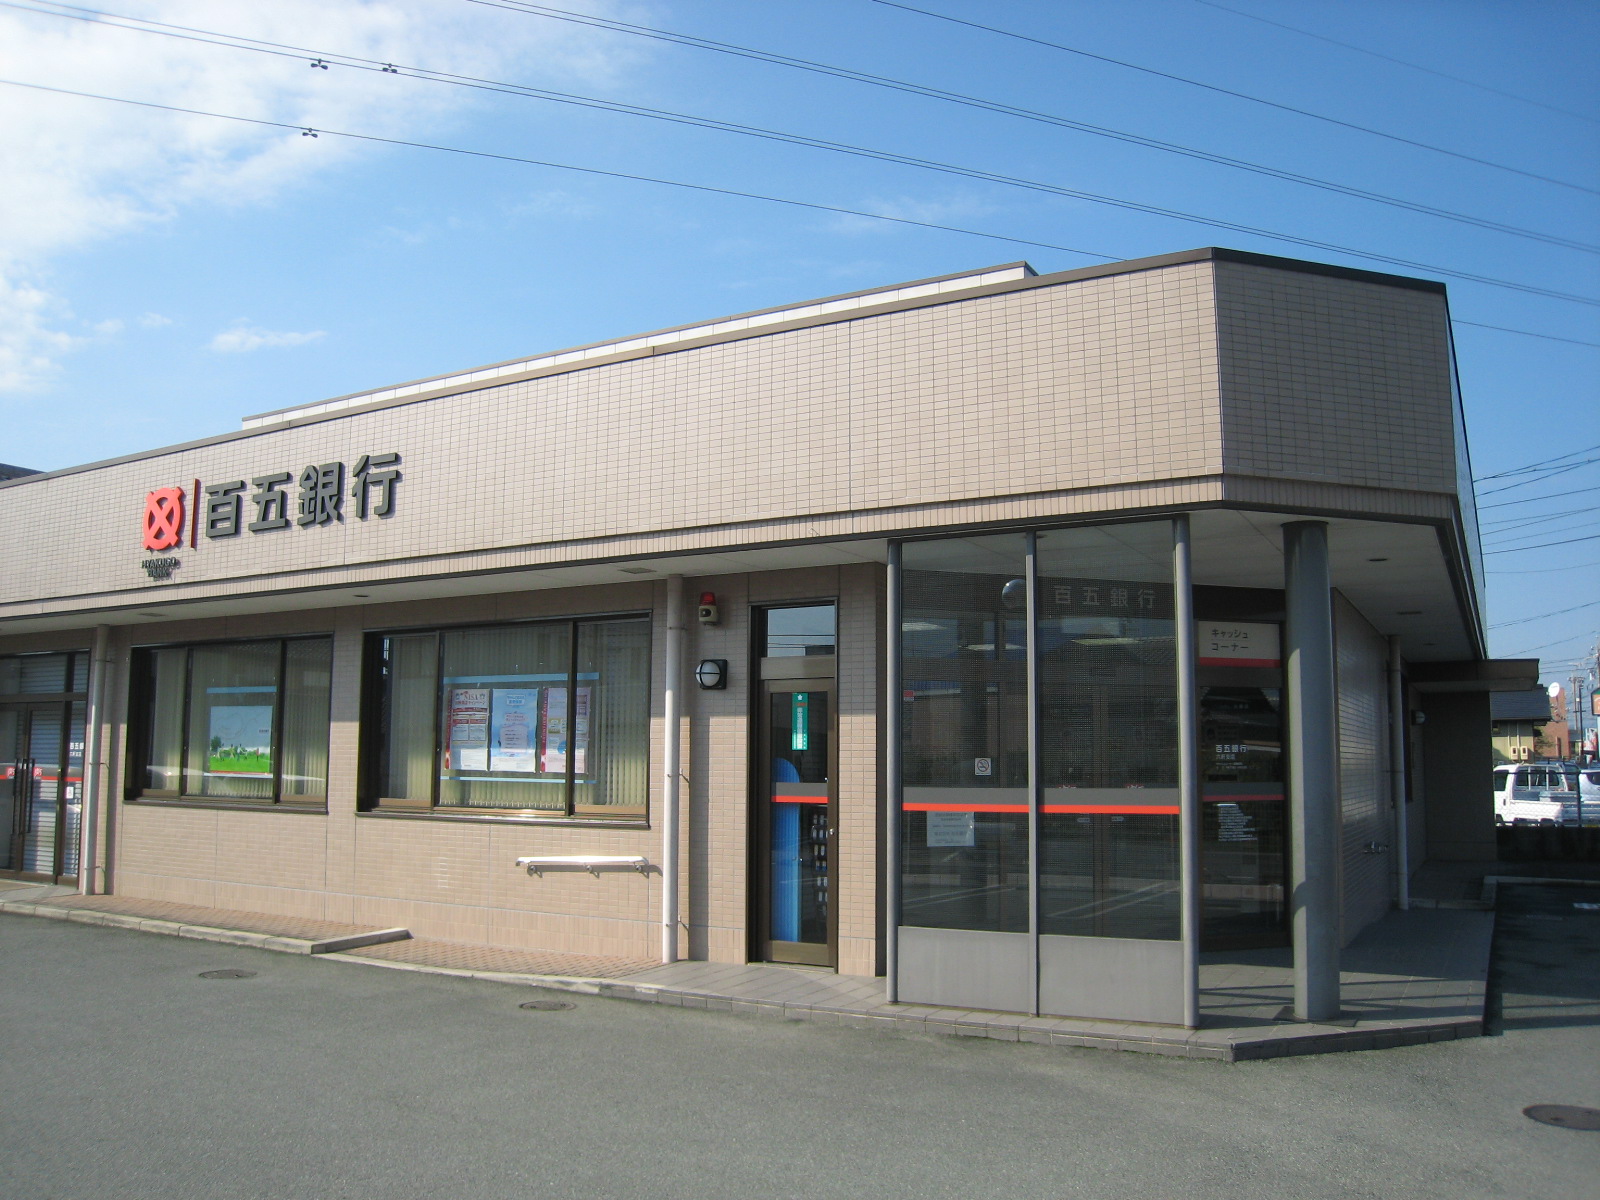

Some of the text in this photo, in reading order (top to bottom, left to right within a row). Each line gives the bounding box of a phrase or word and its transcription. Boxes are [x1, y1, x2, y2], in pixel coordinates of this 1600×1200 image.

[204, 451, 402, 538] 百五銀行
[141, 557, 177, 569] HYAKUGO
[147, 567, 169, 577] BANK
[1053, 584, 1156, 610] 百五銀行
[1211, 628, 1249, 639] キャッシュ
[1211, 642, 1249, 651] コーナー
[1215, 744, 1247, 753] 百五銀行
